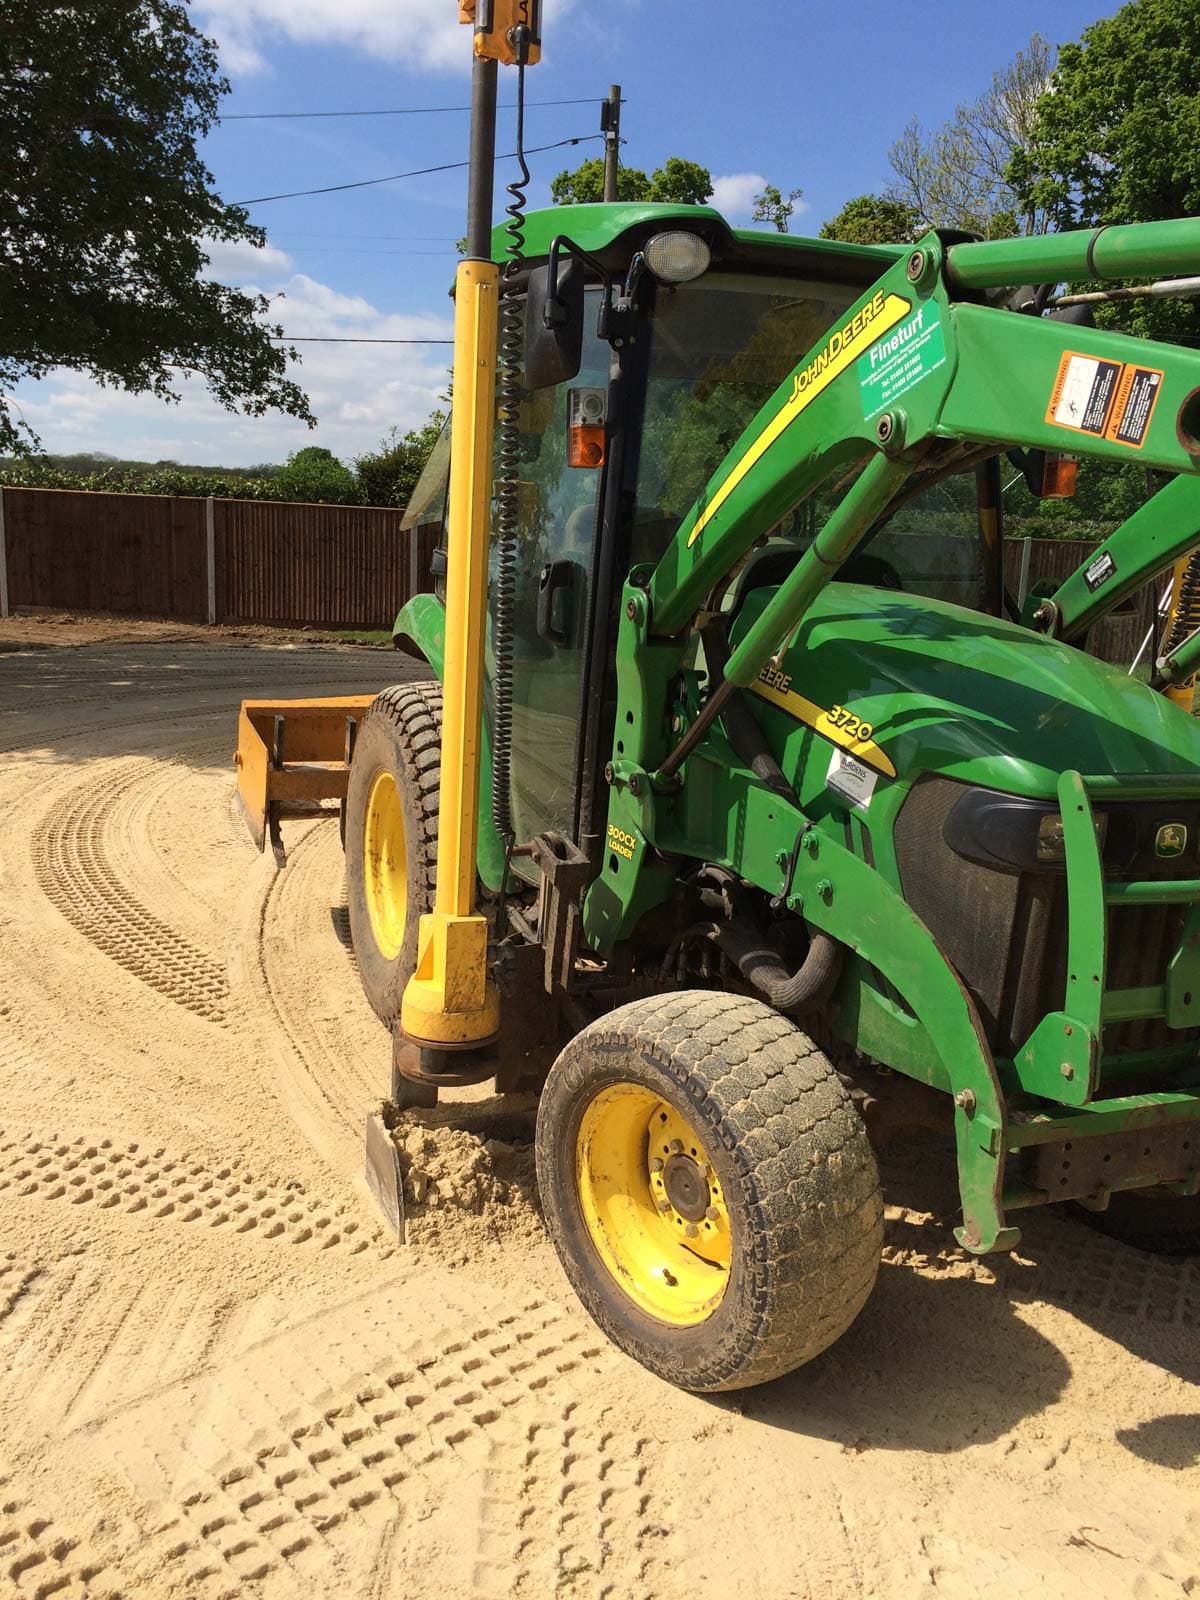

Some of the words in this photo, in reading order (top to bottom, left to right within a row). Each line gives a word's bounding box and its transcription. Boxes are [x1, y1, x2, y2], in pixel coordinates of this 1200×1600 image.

[789, 348, 829, 403] JOHN
[828, 288, 885, 363] DEERE
[869, 308, 924, 369] Fineturf
[1053, 359, 1069, 406] WARNING
[1115, 373, 1133, 420] WARNING
[758, 667, 792, 694] EERE
[826, 704, 873, 742] 3720
[840, 757, 867, 778] BURDENS
[607, 824, 637, 850] 300CX
[608, 838, 633, 860] LOADER
